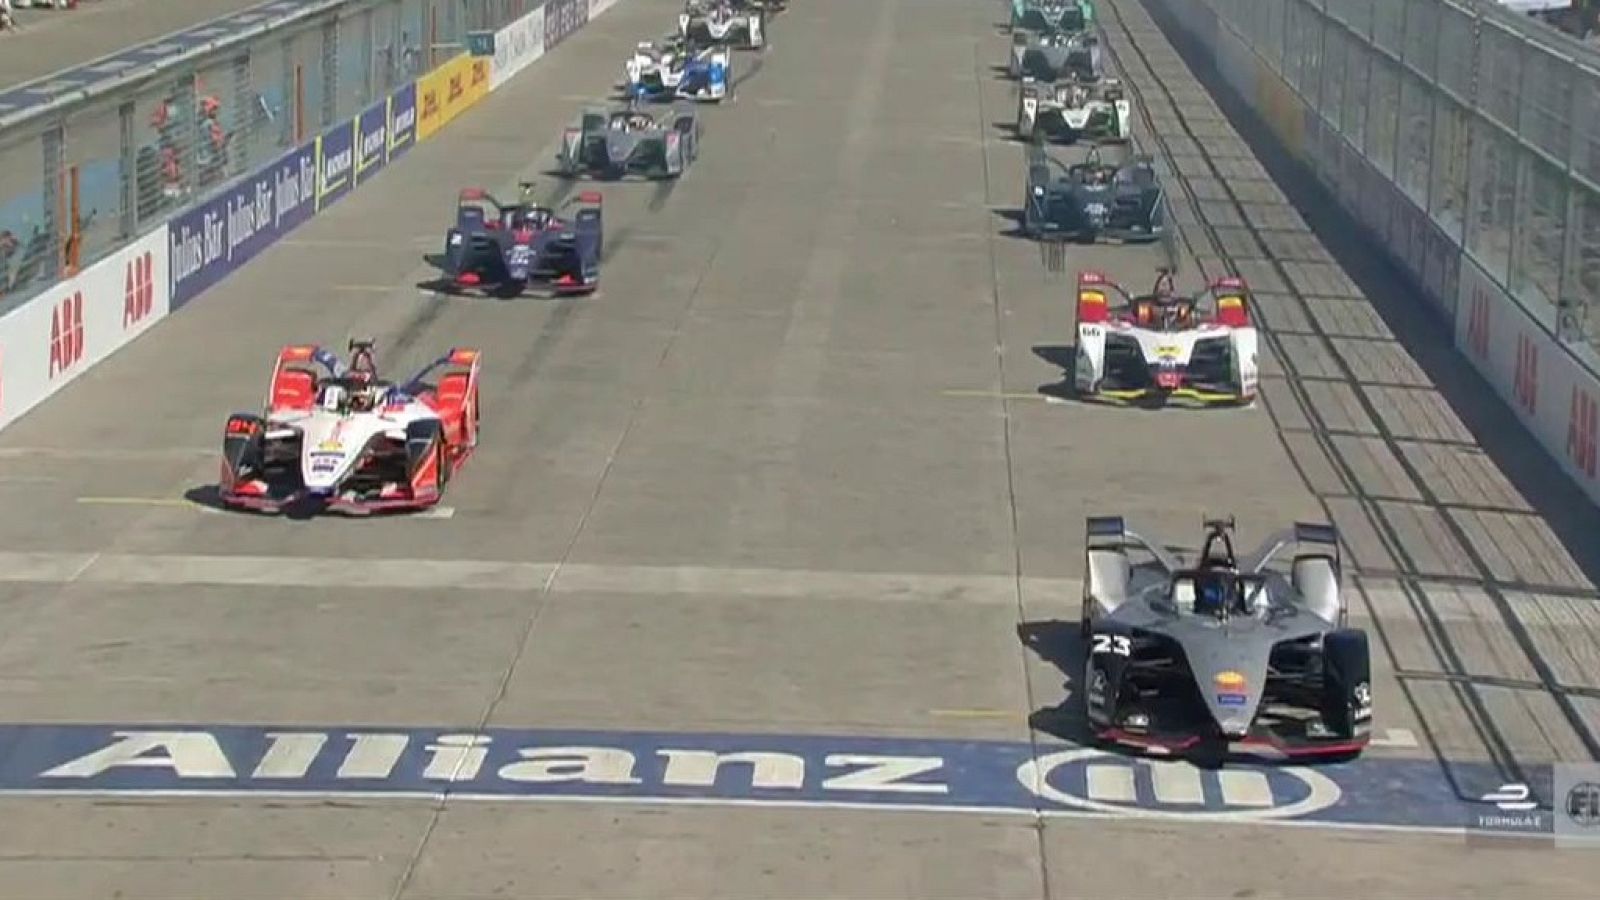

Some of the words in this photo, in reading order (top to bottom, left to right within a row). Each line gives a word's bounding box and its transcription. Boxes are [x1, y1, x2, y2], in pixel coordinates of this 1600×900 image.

[171, 225, 204, 299] Julius
[204, 211, 224, 265] Bär
[228, 195, 256, 262] Julius
[256, 181, 273, 231] Bär
[123, 251, 154, 330] ABB
[49, 290, 84, 380] ABB
[1513, 329, 1537, 417] ABB
[1567, 382, 1598, 480] ABB
[1093, 633, 1131, 657] 23
[37, 731, 949, 794] Allianz
